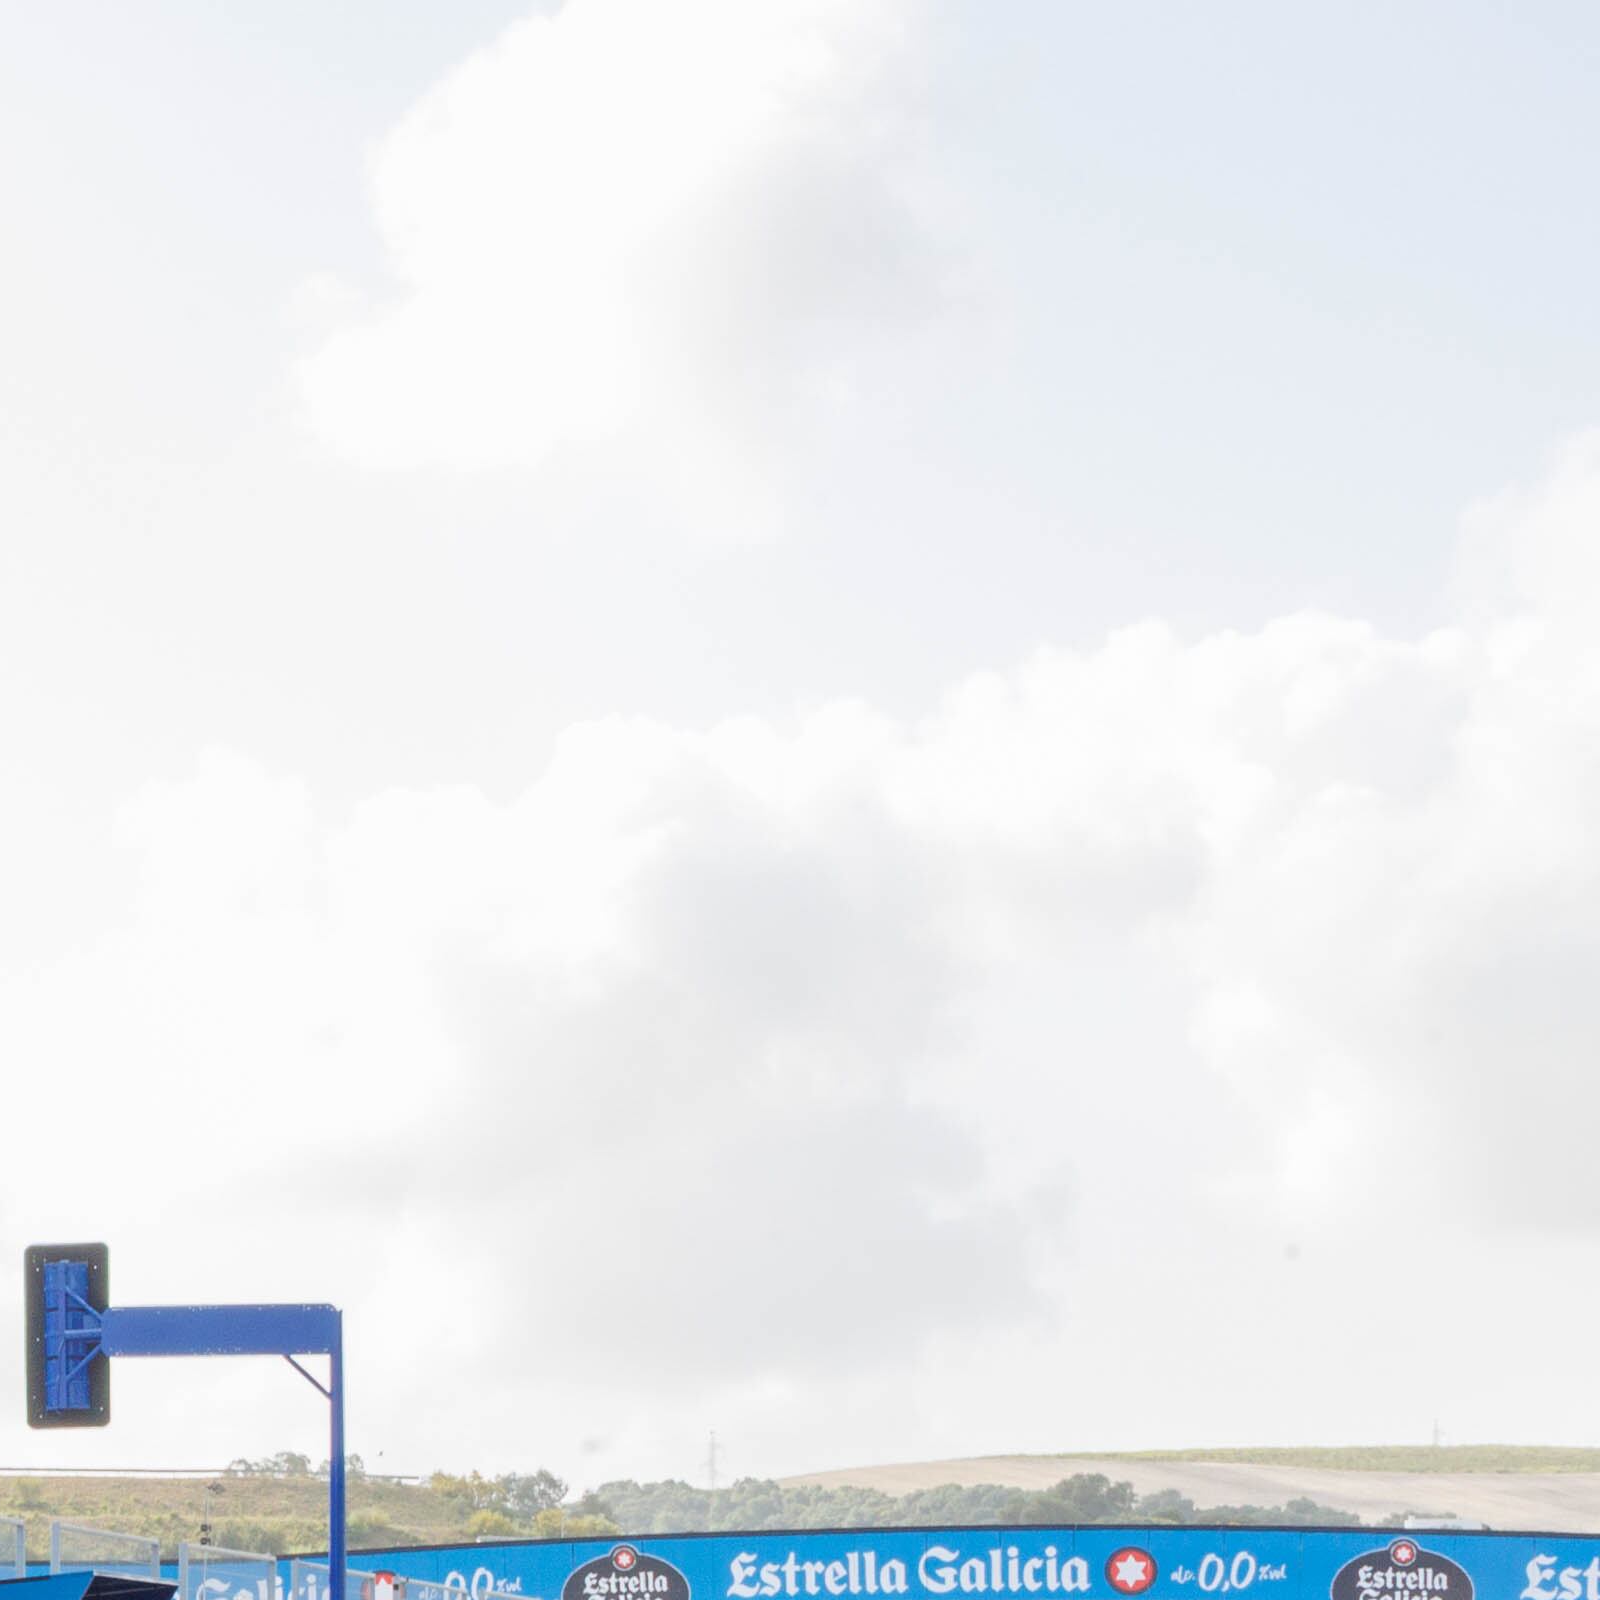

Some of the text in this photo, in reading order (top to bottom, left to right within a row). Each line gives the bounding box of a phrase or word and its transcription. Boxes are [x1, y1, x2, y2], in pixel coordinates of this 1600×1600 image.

[583, 1572, 669, 1595] Estrella
[727, 1545, 1091, 1598] Estrella Galicia
[1356, 1565, 1449, 1591] Estrella
